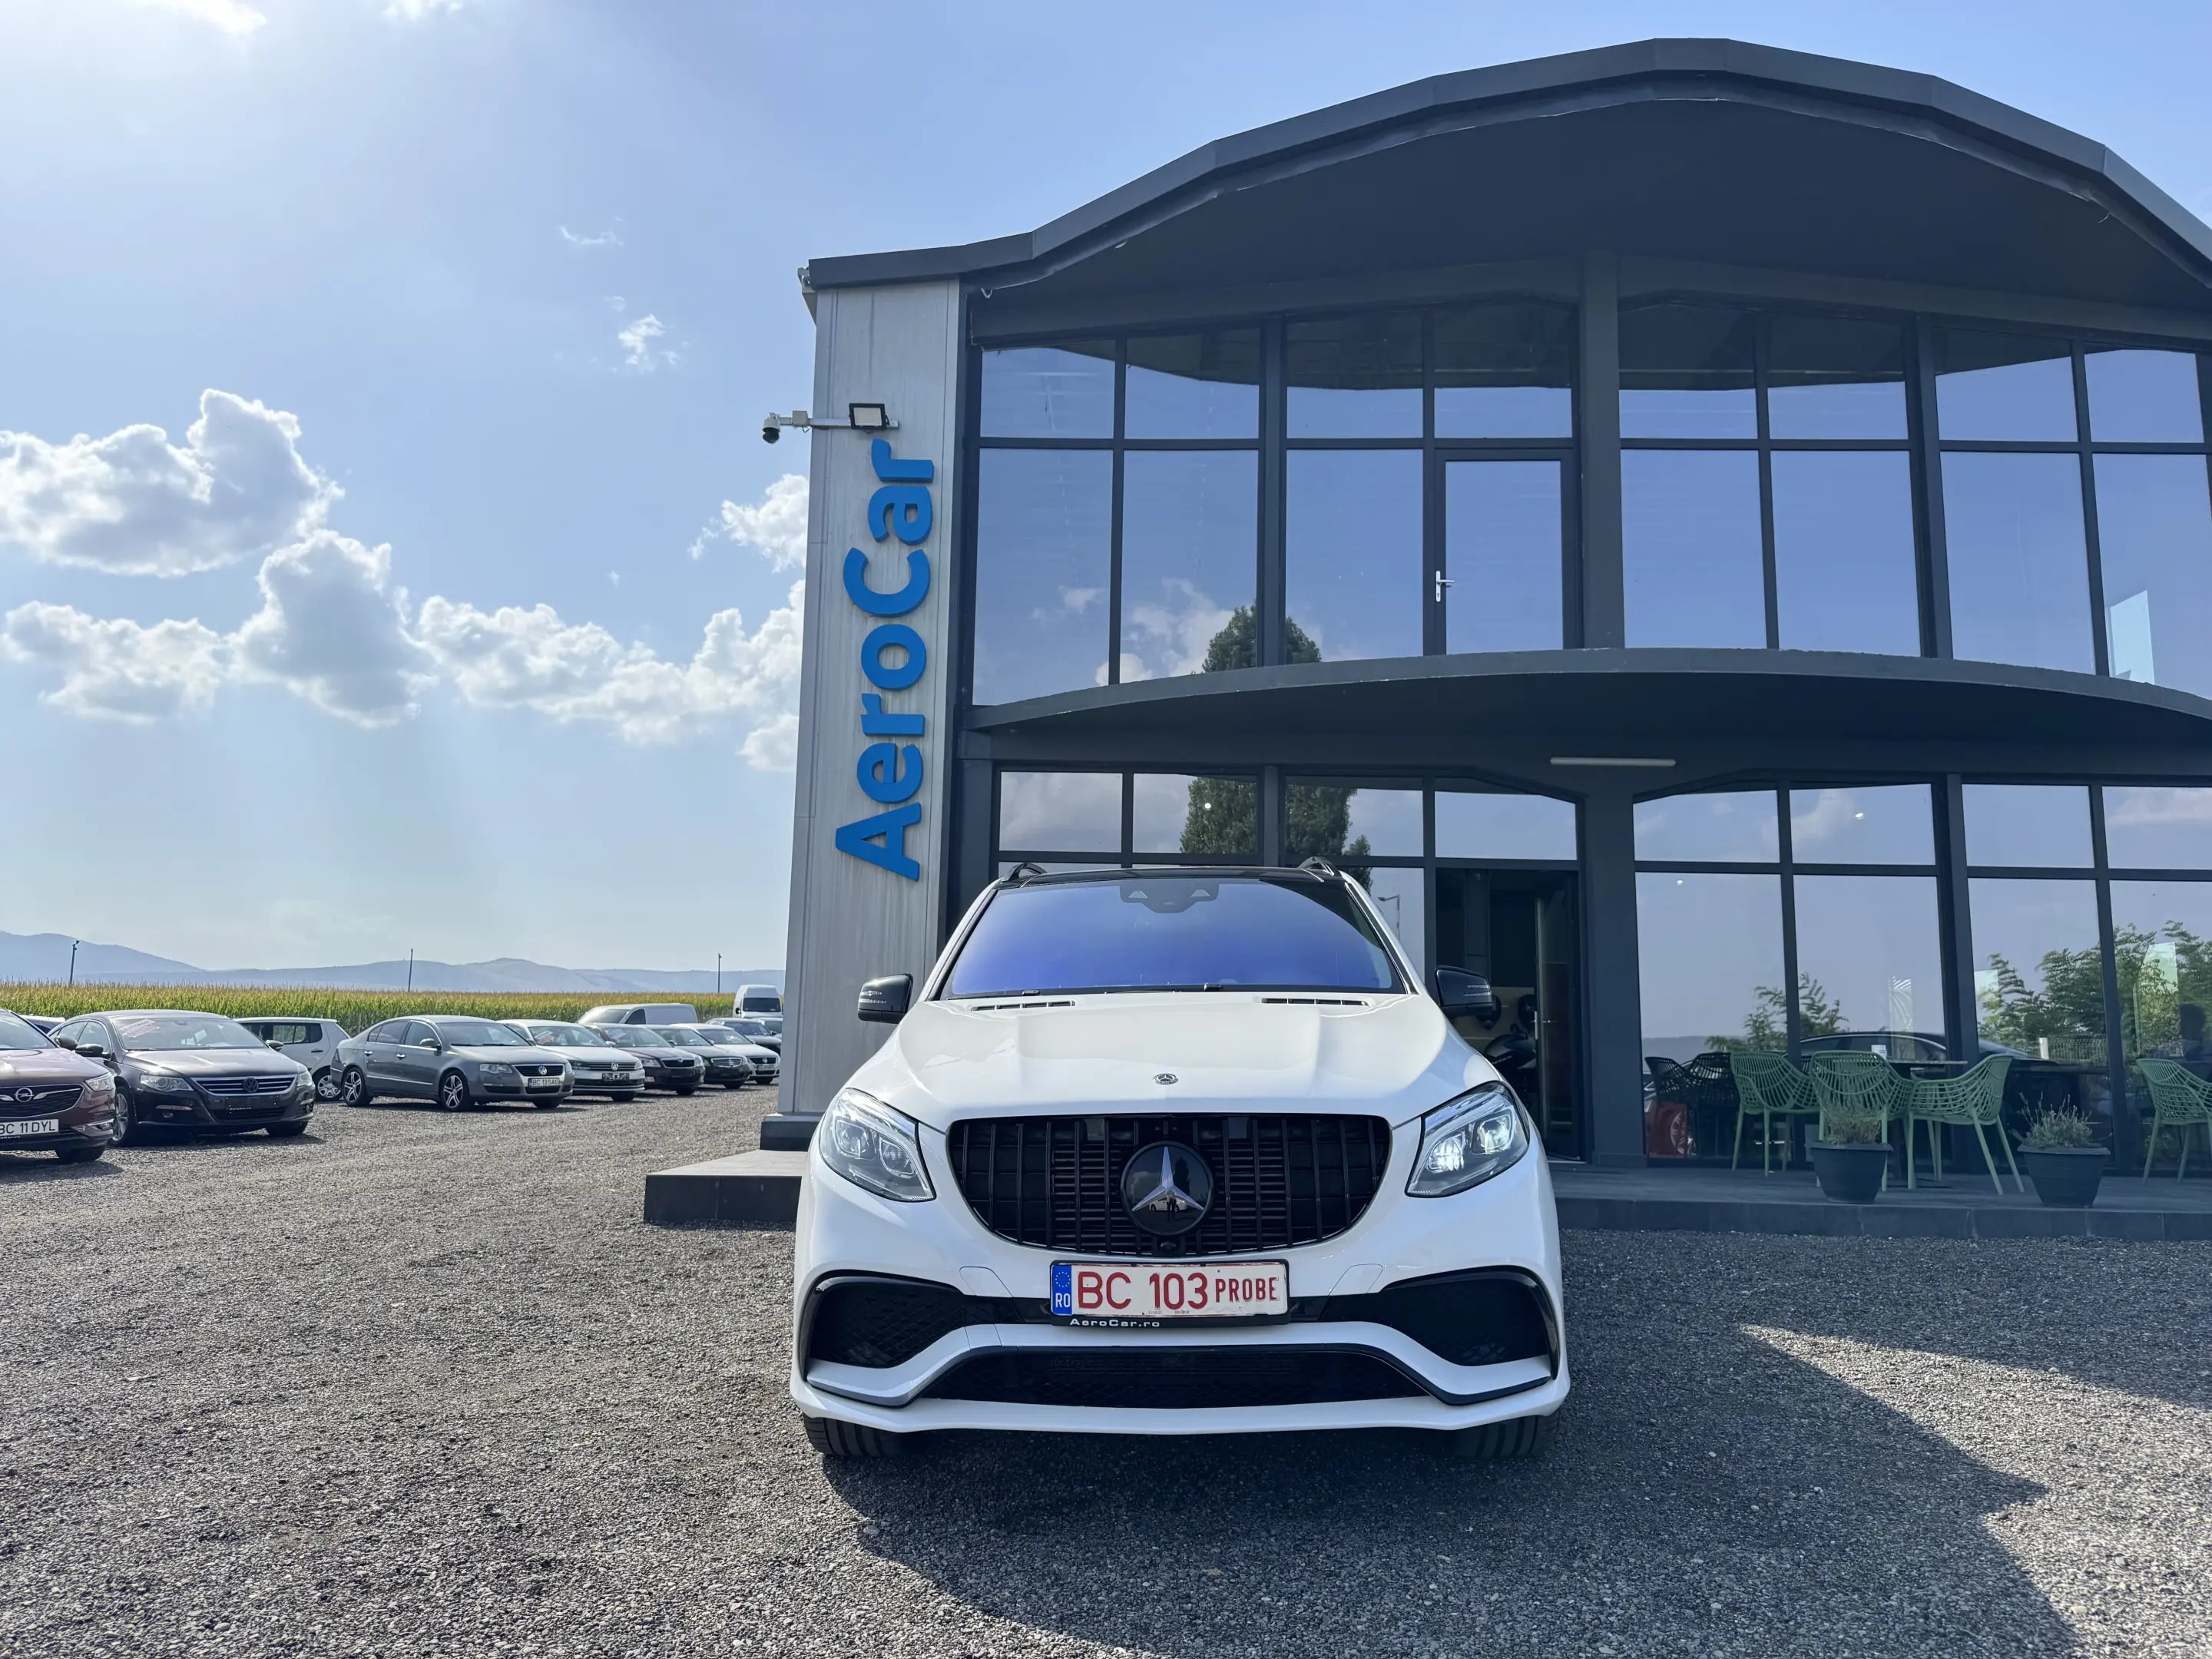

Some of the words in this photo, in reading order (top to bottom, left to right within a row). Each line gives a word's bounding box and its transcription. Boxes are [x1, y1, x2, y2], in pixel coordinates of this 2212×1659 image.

[835, 438, 935, 882] AeroCar
[20, 1122, 28, 1133] 11
[31, 1121, 56, 1133] DYL
[1055, 1293, 1071, 1308] RO
[1078, 1271, 1131, 1310] BC
[1149, 1272, 1208, 1310] 103
[1215, 1277, 1279, 1303] PROBE
[1069, 1318, 1161, 1327] AeroCar.ro
